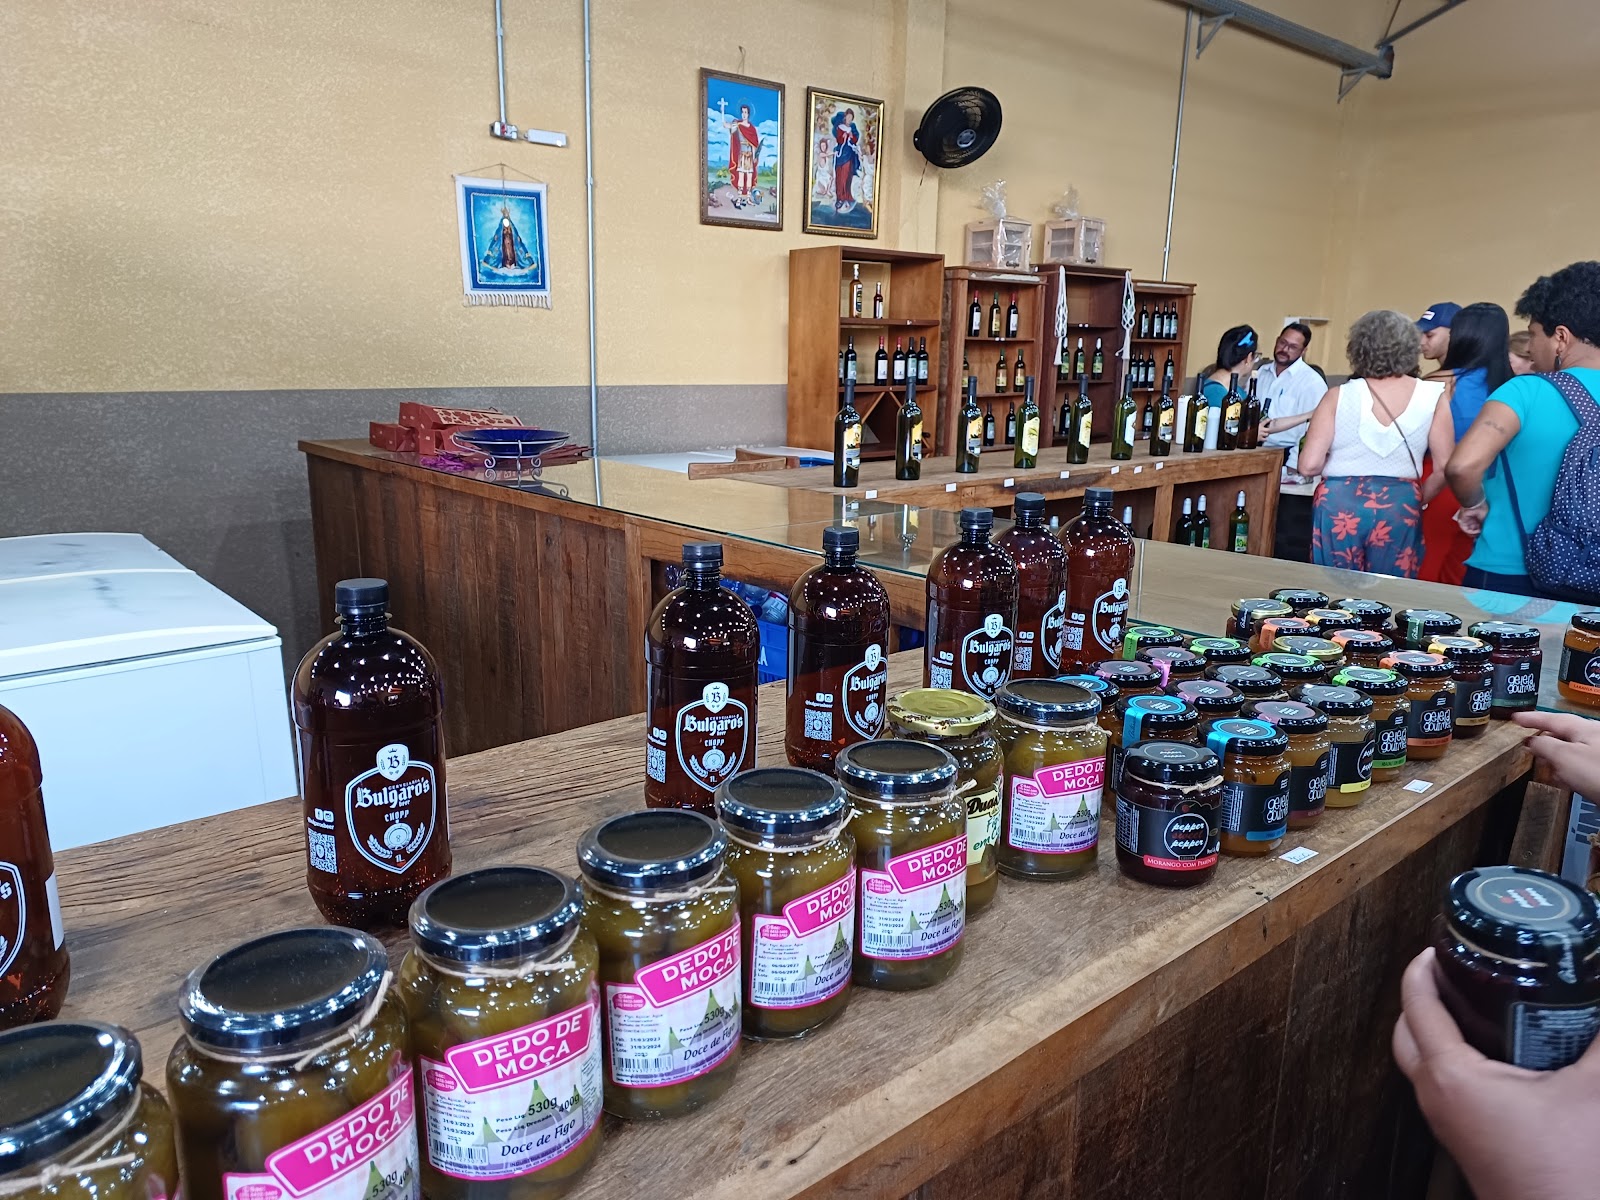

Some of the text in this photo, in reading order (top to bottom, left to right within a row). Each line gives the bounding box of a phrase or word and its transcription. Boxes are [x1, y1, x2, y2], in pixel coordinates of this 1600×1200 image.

[704, 739, 725, 747] CHOPP
[1052, 761, 1105, 782] DEDO DE
[355, 777, 430, 808] Bulgaro's
[1064, 774, 1099, 791] MOÇA
[384, 809, 410, 823] CHOPP
[1059, 832, 1078, 840] Doce
[1078, 829, 1086, 837] de
[1171, 822, 1204, 832] pepper
[1170, 839, 1204, 849] pepper
[395, 854, 405, 862] 1L
[908, 839, 967, 873] DEDO DE
[1147, 857, 1181, 868] MORANGO
[922, 858, 962, 882] MOÇA
[806, 880, 849, 914] DEDO
[920, 930, 941, 941] Doce
[942, 925, 951, 934] de
[661, 930, 739, 982] DEDO DE
[681, 955, 733, 991] MOÇA
[814, 972, 834, 986] Doce
[834, 966, 843, 976] de
[704, 1006, 725, 1024] 530g
[472, 1013, 583, 1067] DEDO DE
[683, 1047, 708, 1061] Doce
[710, 1037, 721, 1048] de
[495, 1041, 570, 1079] MOÇA
[527, 1096, 558, 1117] 530g
[558, 1094, 580, 1113] 400g
[304, 1080, 410, 1164] DEDO DE
[443, 1118, 474, 1128] 31/03/2023
[443, 1126, 475, 1136] 31/03/2024
[330, 1113, 402, 1171] MOÇA
[501, 1119, 576, 1157] Doce de Figo
[372, 1170, 398, 1197] 530g
